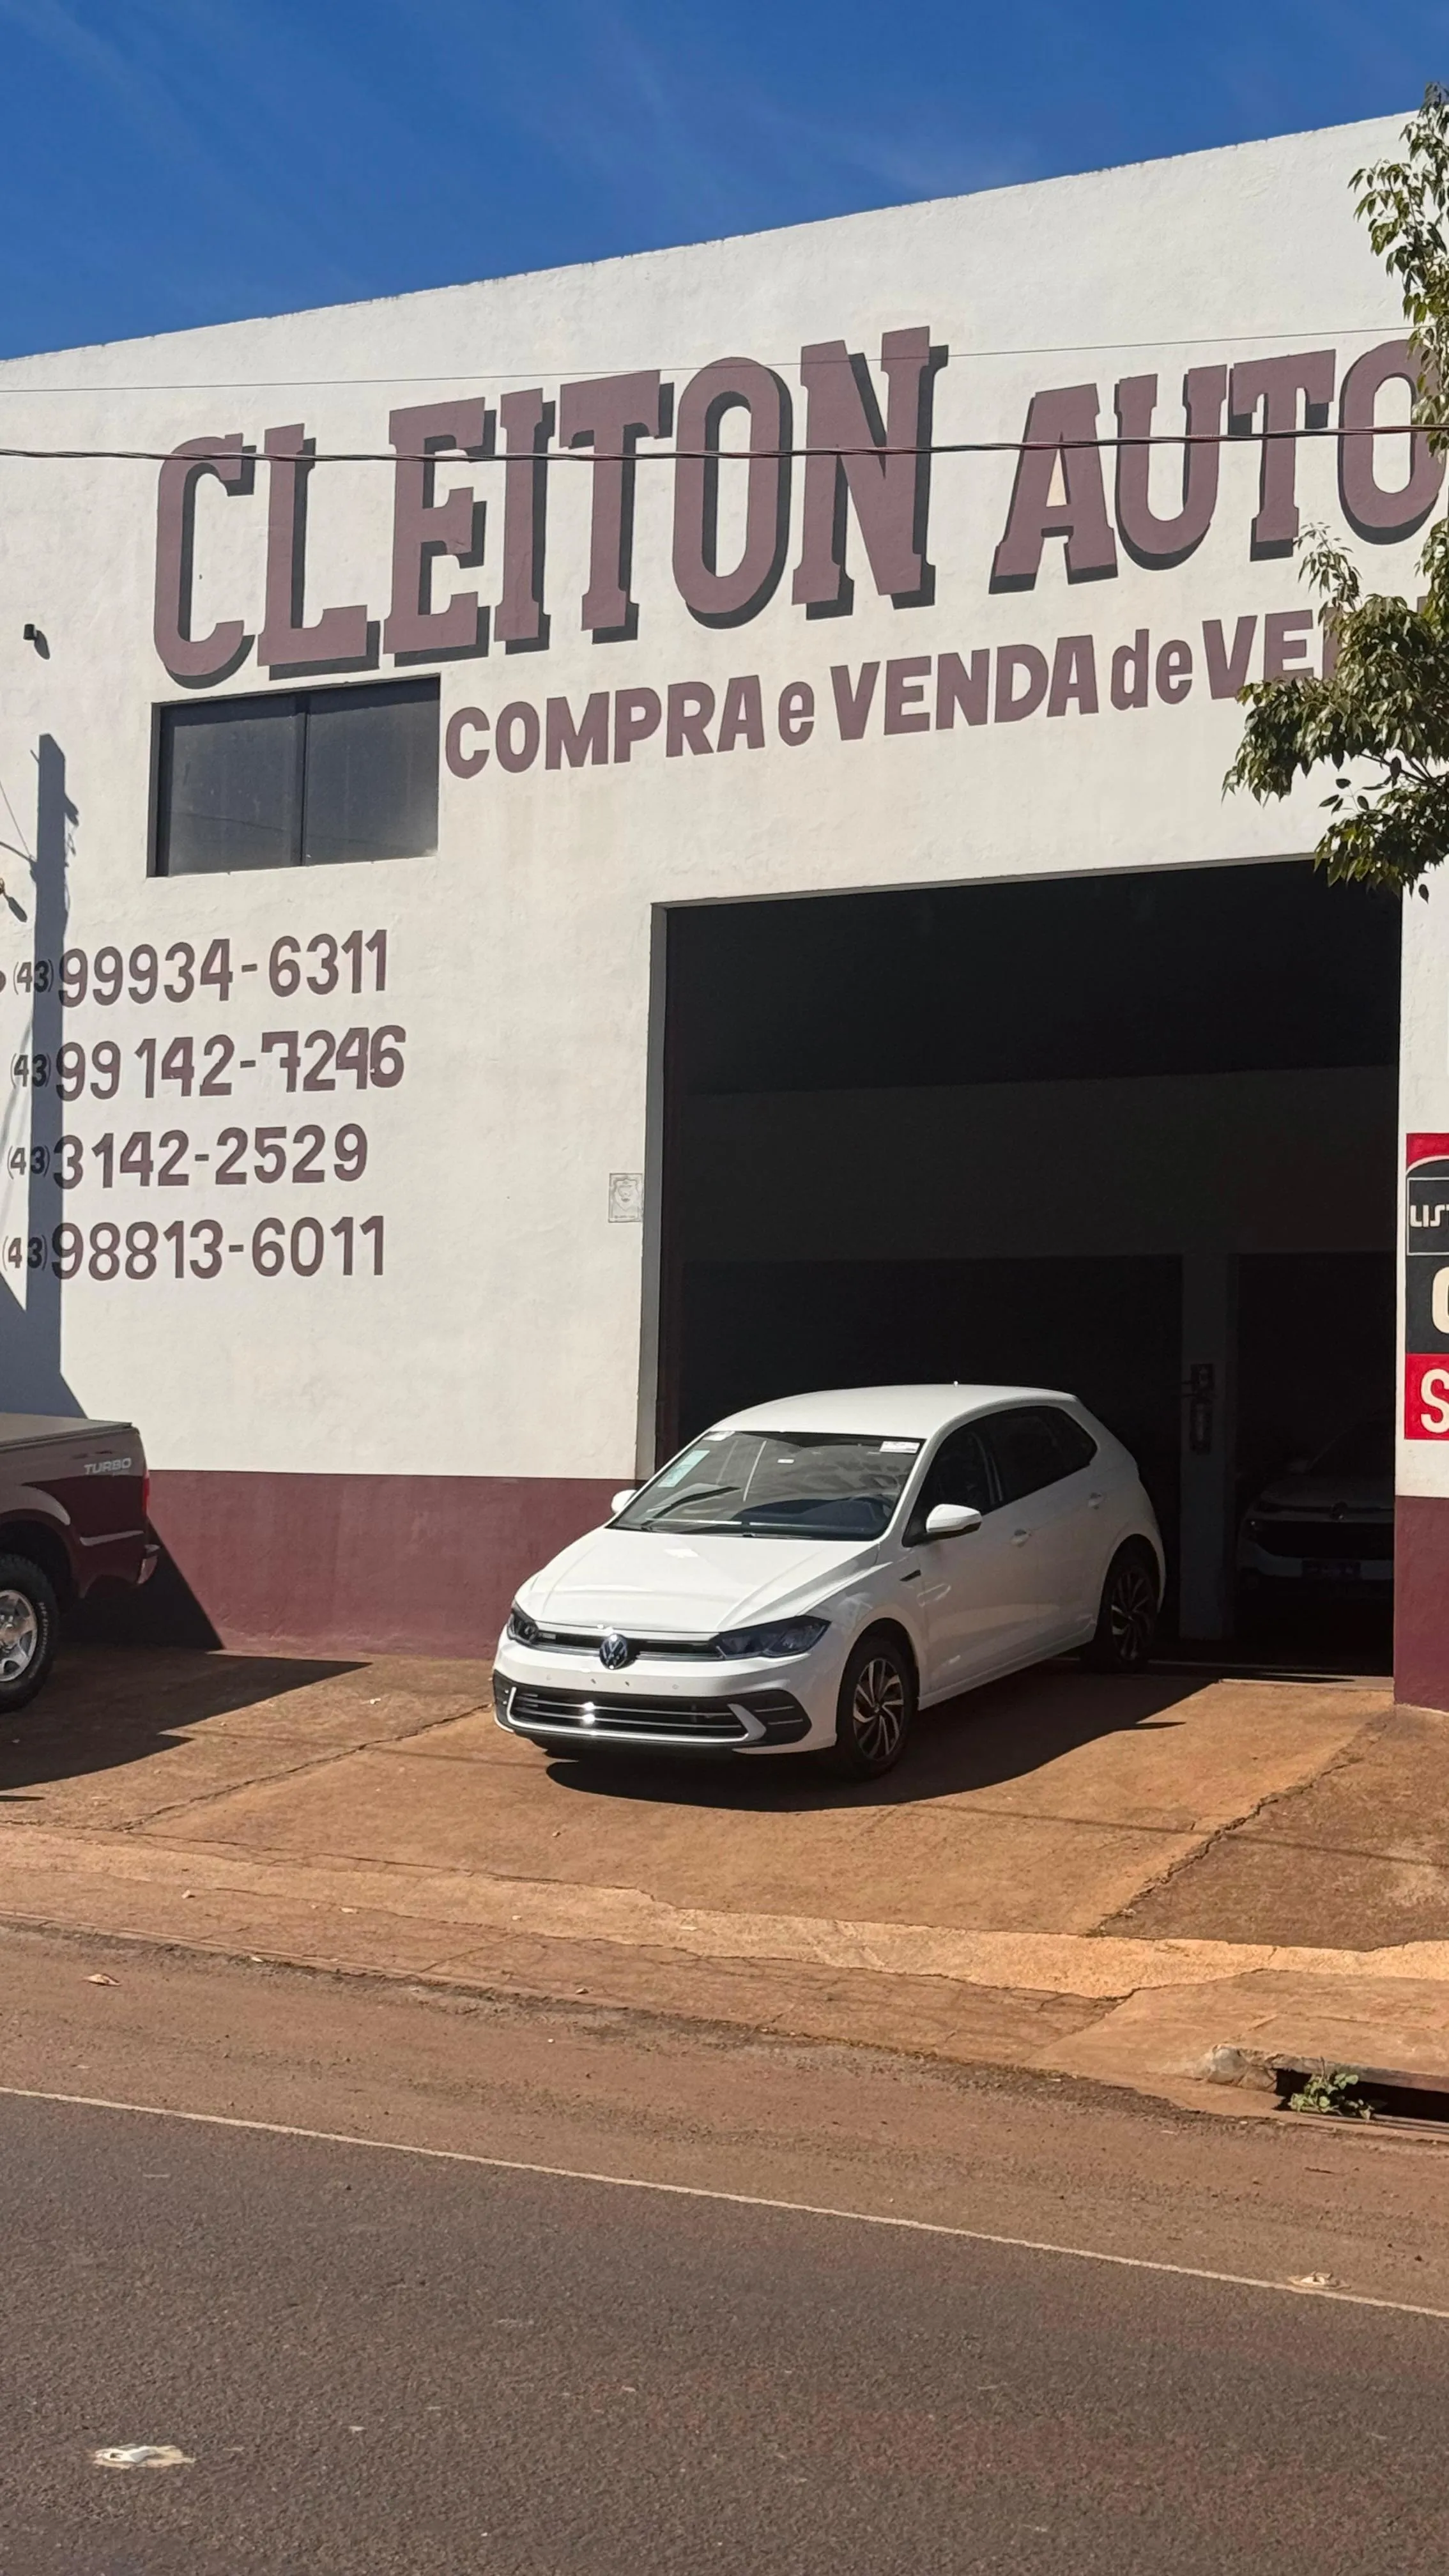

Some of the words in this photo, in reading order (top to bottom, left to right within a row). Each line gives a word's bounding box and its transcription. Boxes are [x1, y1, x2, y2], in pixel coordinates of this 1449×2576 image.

[153, 325, 949, 690] CLEITON
[445, 674, 766, 779] COMPRA
[778, 681, 815, 747] e
[830, 634, 1100, 741] VENDA
[1110, 629, 1193, 711] de
[84, 1457, 132, 1475] TURBO
